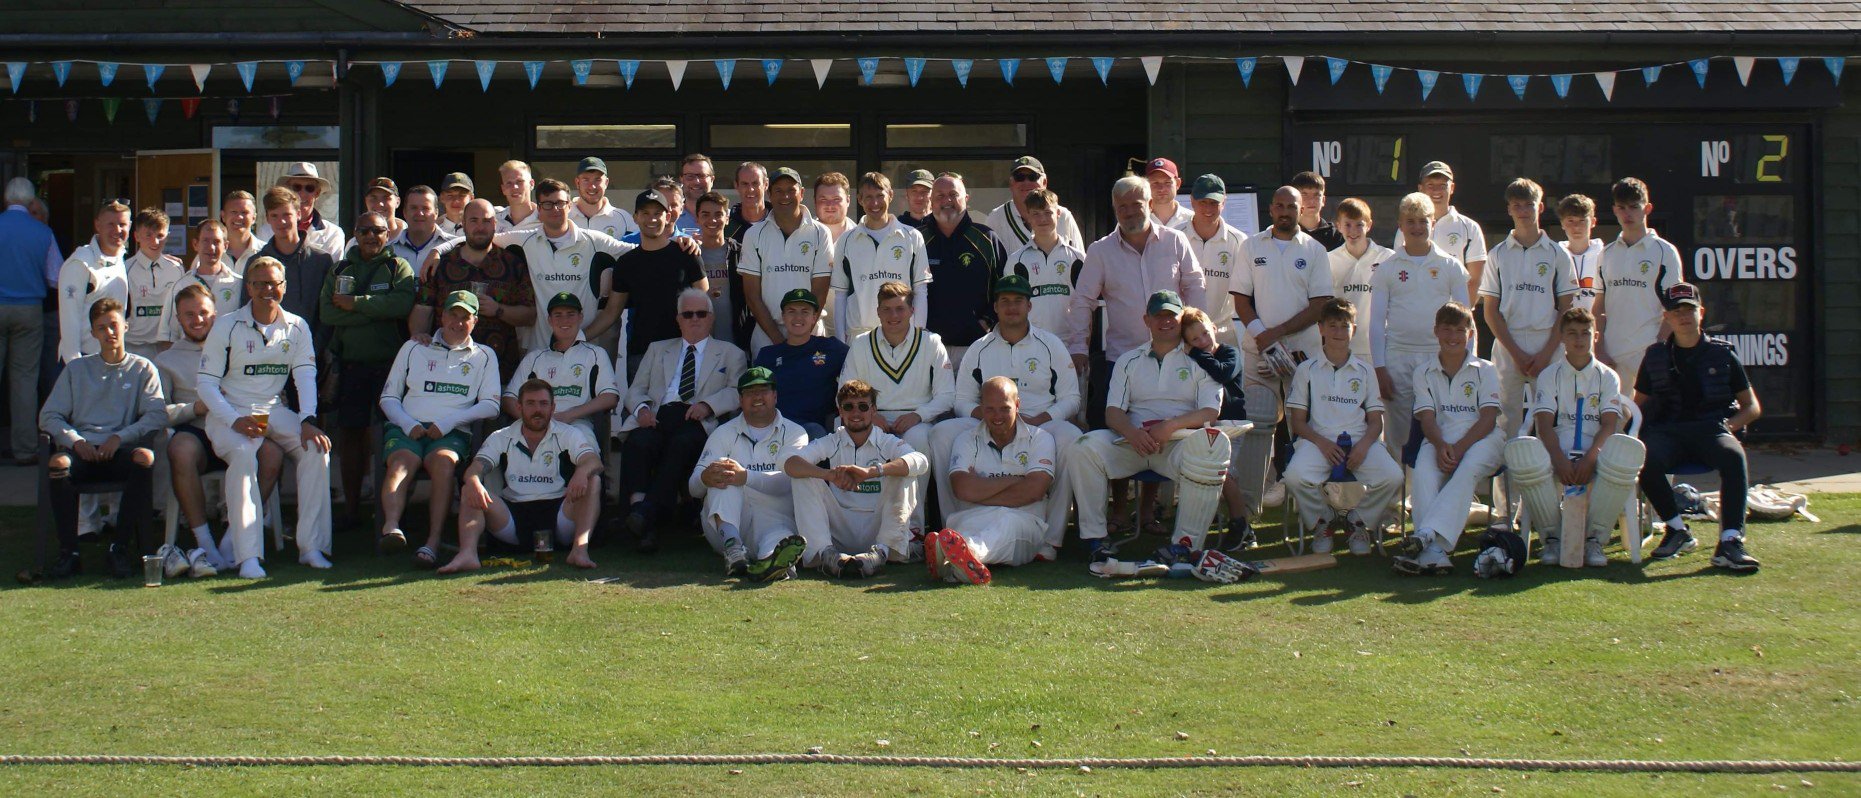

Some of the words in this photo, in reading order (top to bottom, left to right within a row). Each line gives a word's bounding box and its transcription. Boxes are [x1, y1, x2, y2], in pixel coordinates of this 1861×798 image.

[1390, 137, 1402, 181] 1
[1756, 135, 1788, 182] 2
[775, 263, 810, 272] ashtons
[1694, 247, 1797, 280] OVERS
[545, 273, 581, 281] ashtons
[869, 271, 903, 280] ashtons
[1203, 268, 1230, 279] htons
[1614, 277, 1647, 288] ashtons
[1043, 285, 1068, 293] ashtons
[258, 365, 287, 375] ashtons
[438, 384, 468, 395] ashtons
[1328, 395, 1358, 404] ashtons
[1441, 405, 1476, 413] ashtons
[518, 475, 554, 484] ashtons
